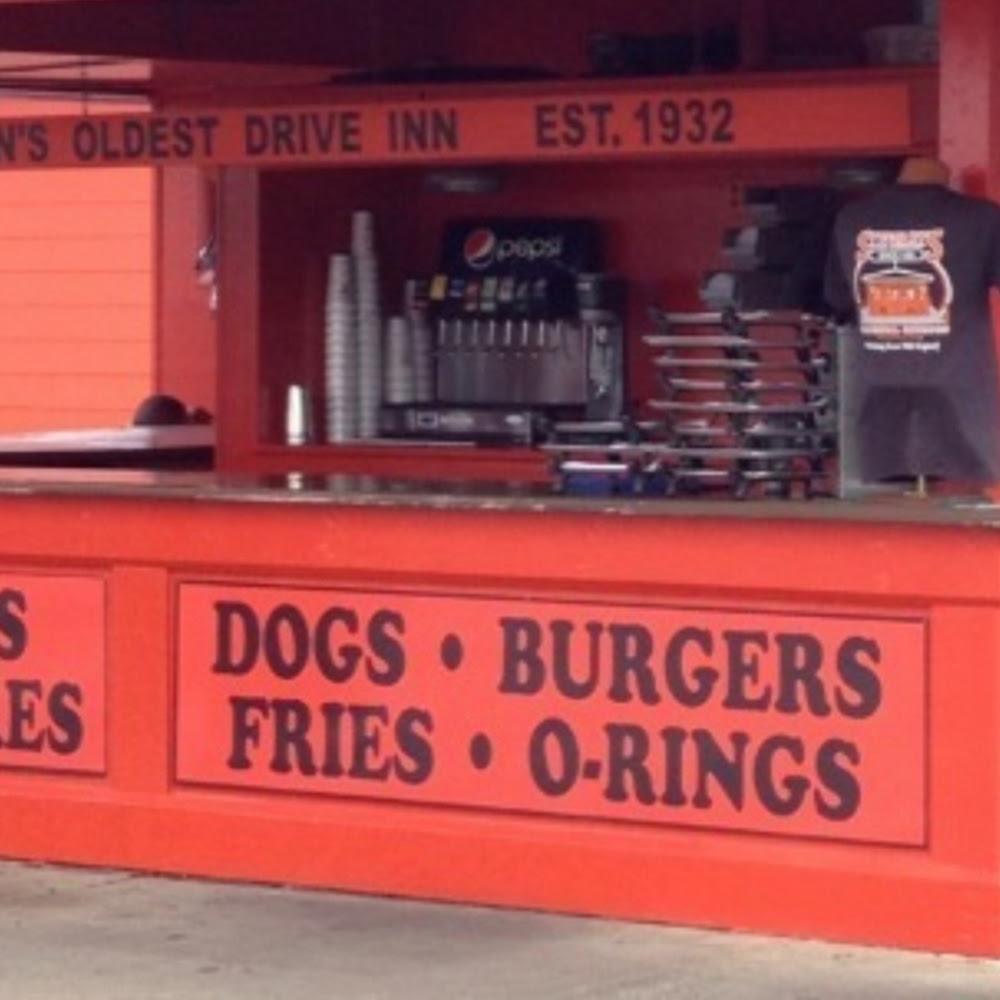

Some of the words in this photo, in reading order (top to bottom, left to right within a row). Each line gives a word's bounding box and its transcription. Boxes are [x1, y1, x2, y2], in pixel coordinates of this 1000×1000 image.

[72, 117, 219, 162] OLDEST
[244, 111, 362, 156] DRIVE
[388, 108, 460, 152] INN
[534, 103, 622, 148] EST.
[634, 98, 736, 145] 1932
[496, 236, 562, 262] pepsi
[211, 601, 406, 686] DOGS
[498, 616, 882, 719] BURGERS
[0, 679, 84, 756] ES
[226, 695, 435, 785] FRIES
[528, 716, 862, 822] O-RINGS
